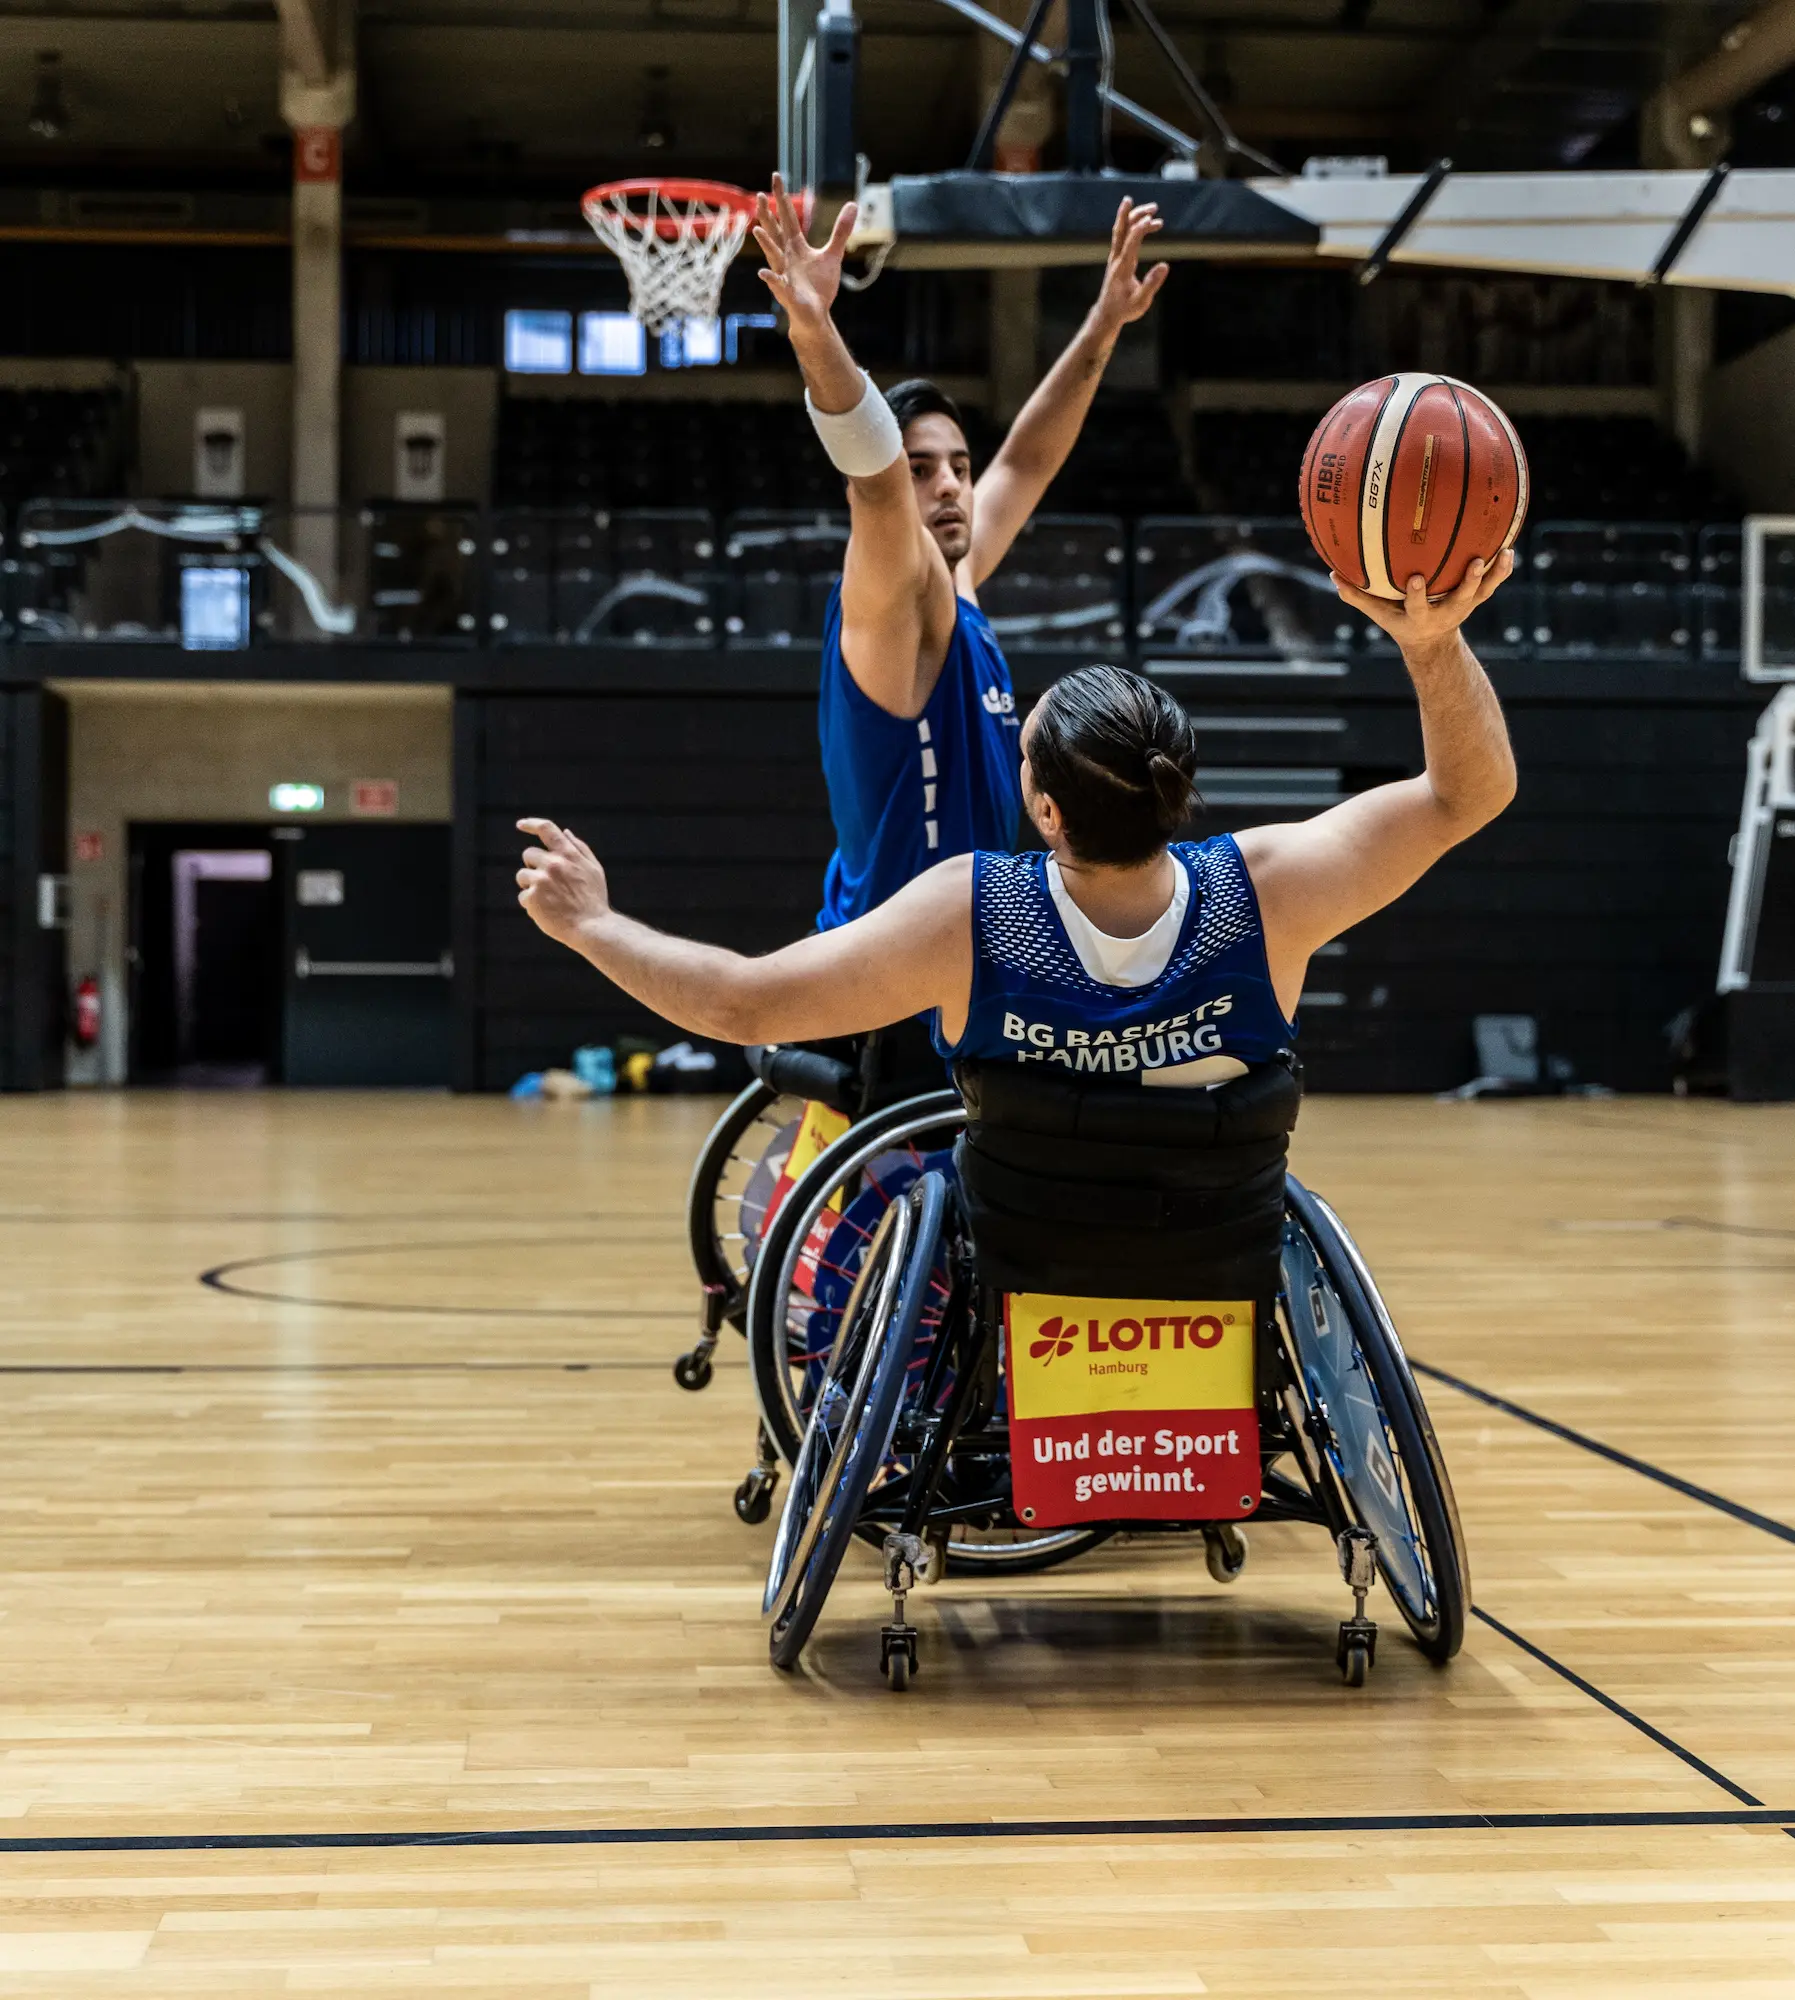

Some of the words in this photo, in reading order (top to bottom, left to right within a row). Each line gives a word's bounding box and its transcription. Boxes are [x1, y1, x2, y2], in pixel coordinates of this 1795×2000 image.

[1317, 453, 1337, 504] FIBA
[1333, 455, 1347, 505] APPROVED
[1369, 460, 1384, 509] GG7X
[1418, 455, 1430, 507] COMPETITION
[1003, 1011, 1054, 1048] BG
[1067, 994, 1233, 1048] BASKETS
[1017, 1024, 1222, 1073] HAMBURG
[1088, 1315, 1224, 1352] LOTTO
[1089, 1361, 1148, 1376] Hamburg
[1033, 1433, 1090, 1463] Und
[1097, 1429, 1146, 1456] der
[1154, 1429, 1240, 1462] Sport
[1075, 1464, 1206, 1502] gewinnt.
